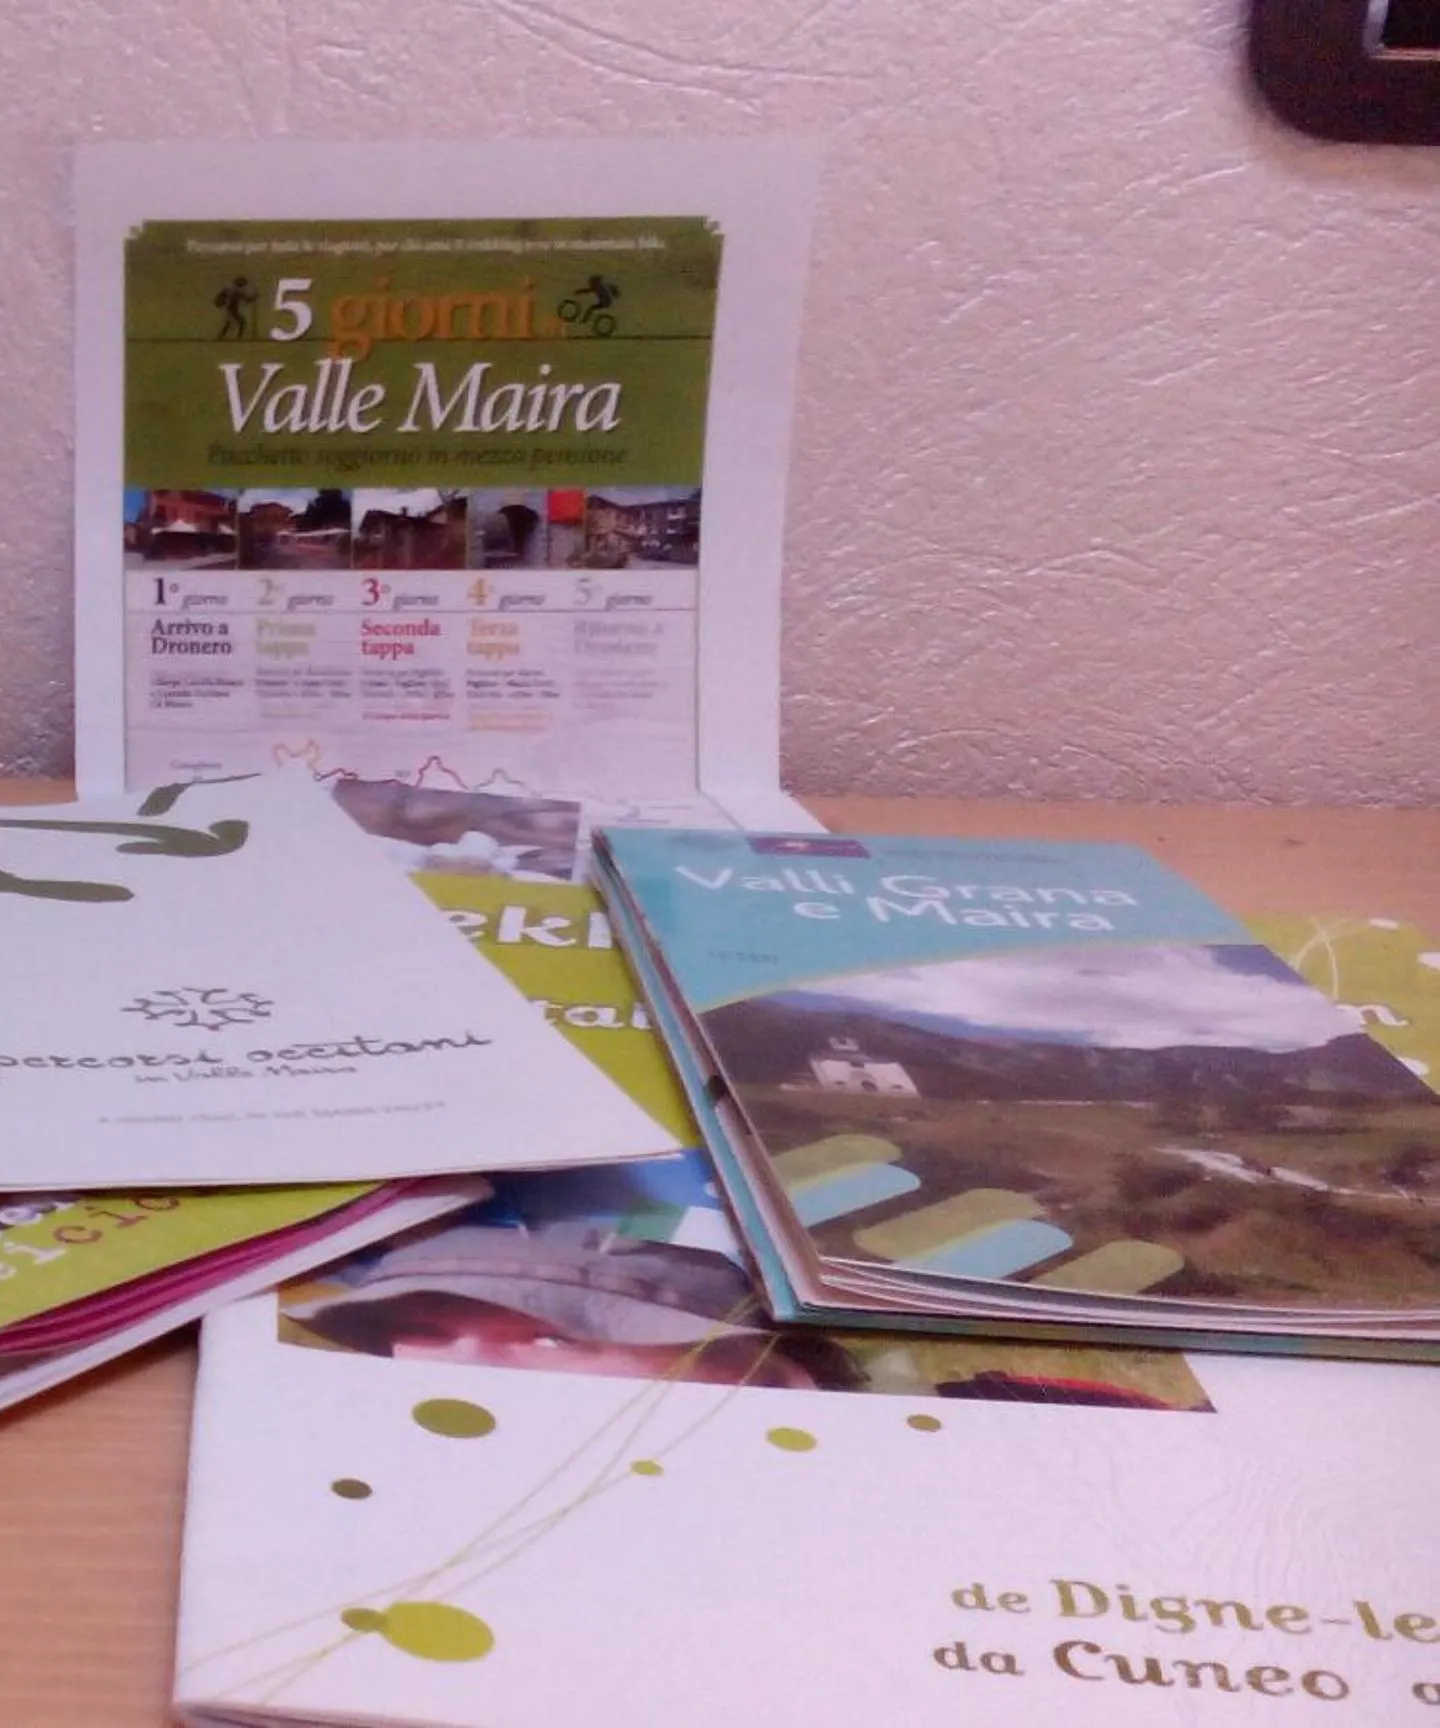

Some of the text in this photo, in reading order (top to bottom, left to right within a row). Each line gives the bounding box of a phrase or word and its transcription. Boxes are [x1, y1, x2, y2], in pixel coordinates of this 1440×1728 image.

[271, 274, 539, 362] 5 giorni
[218, 357, 622, 433] Valle Maira
[150, 619, 229, 636] Arrivo a
[361, 618, 442, 637] Seconda
[468, 618, 520, 637] Terza
[151, 637, 233, 656] Dronero
[362, 640, 416, 661] tappa
[466, 641, 521, 661] tappa
[671, 864, 1139, 906] Valli Grana
[792, 895, 1116, 932] e Maira
[246, 1030, 493, 1062] occitani
[950, 1581, 1032, 1614] de
[932, 1640, 1025, 1677] da
[1053, 1639, 1350, 1702] Cuneo
